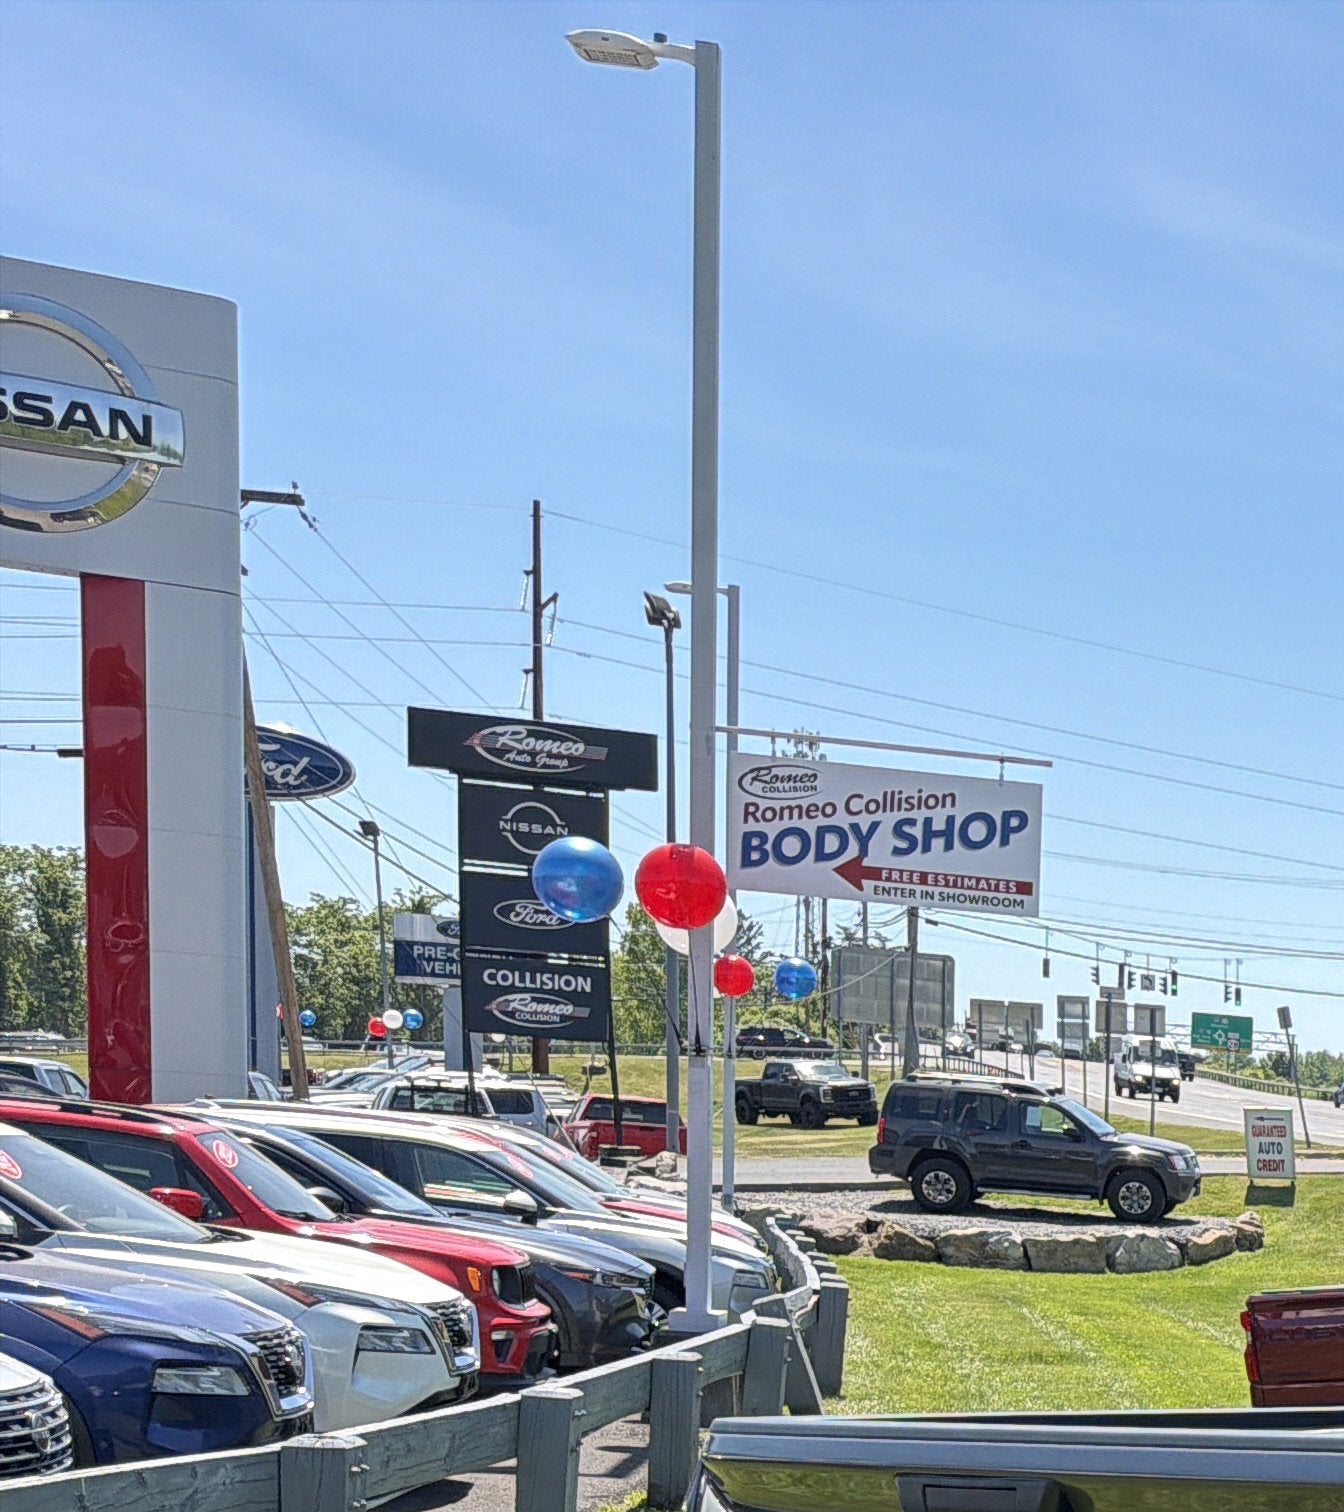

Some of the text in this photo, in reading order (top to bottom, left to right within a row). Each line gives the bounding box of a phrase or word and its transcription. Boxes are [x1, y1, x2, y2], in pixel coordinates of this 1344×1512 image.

[496, 725, 585, 756] Romeo
[503, 749, 569, 768] Auto Group
[749, 766, 818, 785] Romeo
[762, 784, 818, 794] COLLISION
[742, 788, 957, 825] Romeo Collision
[499, 820, 569, 836] NISSAN
[740, 809, 1029, 870] BODY SHOP
[881, 869, 1018, 894] FREE ESTIMATES
[873, 884, 1025, 909] ENTER IN SHOWROOM
[482, 968, 592, 993] COLLISION
[507, 996, 574, 1015] Romeo
[515, 1011, 561, 1023] COLLISION
[1258, 1141, 1283, 1155] AUTO
[1256, 1158, 1286, 1173] CREDIT
